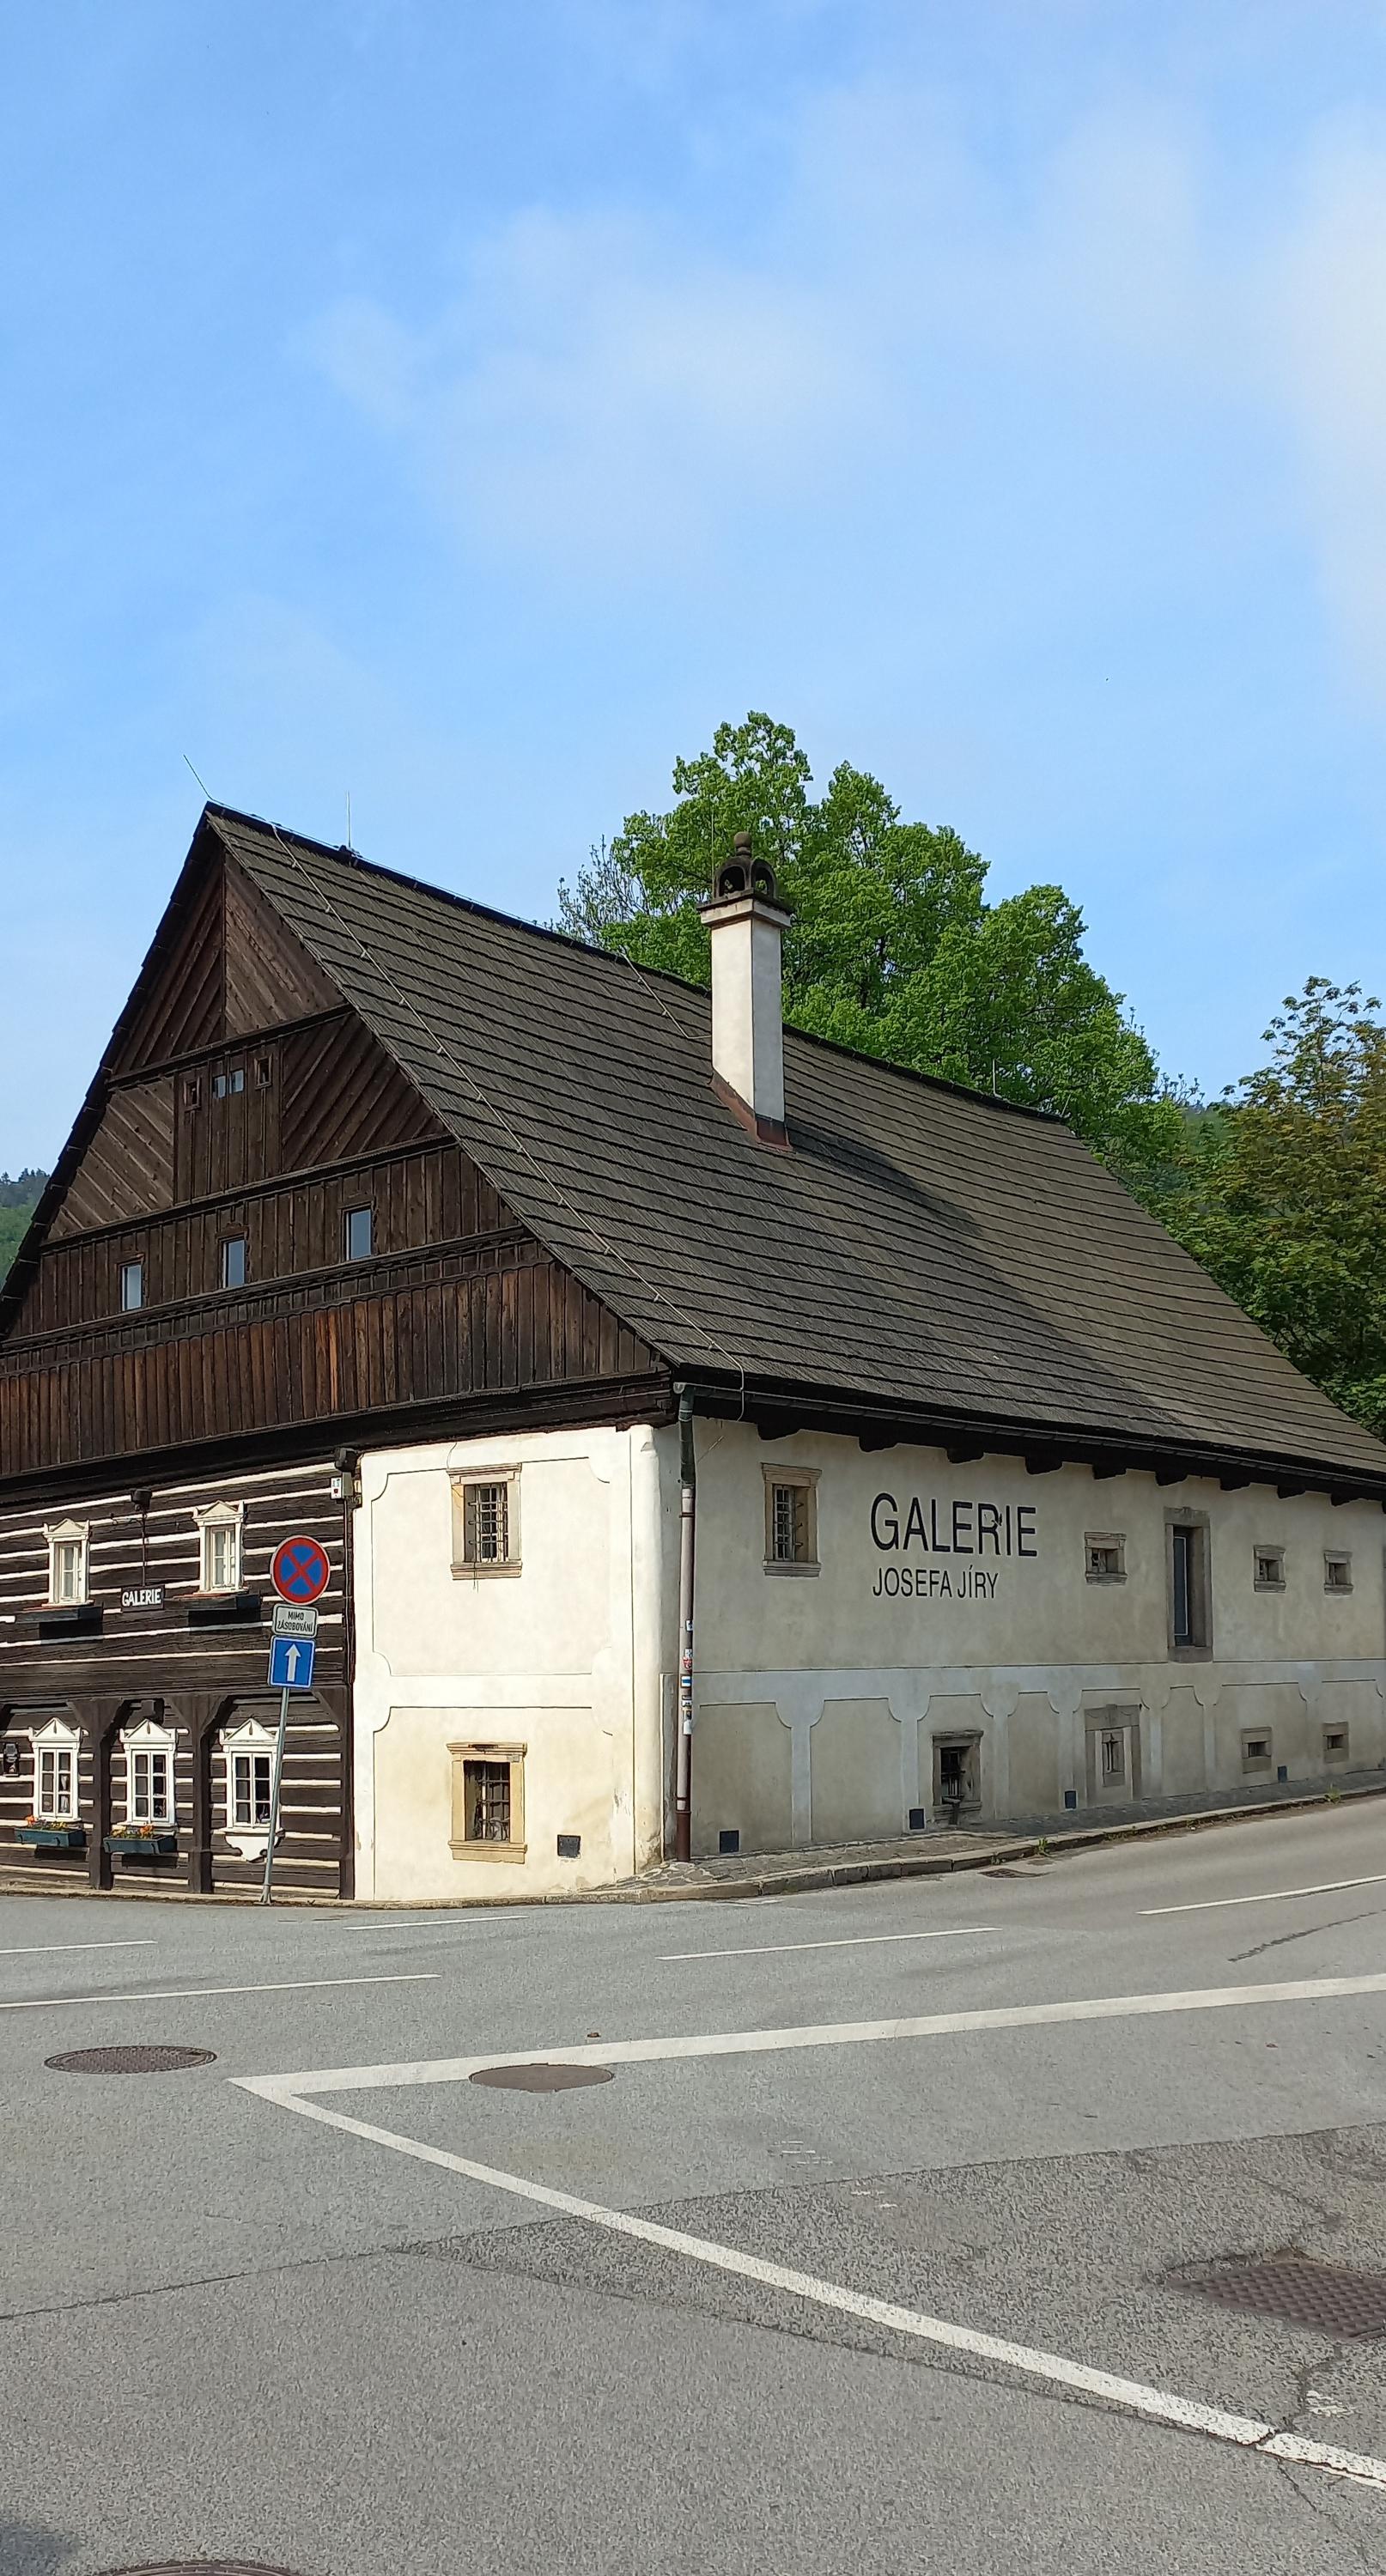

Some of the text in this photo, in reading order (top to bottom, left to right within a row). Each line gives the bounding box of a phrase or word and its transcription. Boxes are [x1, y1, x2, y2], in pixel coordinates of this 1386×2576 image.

[871, 1492, 1037, 1557] GALERIE
[872, 1564, 999, 1598] JOSEFA JÍRY
[122, 1589, 161, 1607] GALERIE
[288, 1611, 304, 1620] MIMO
[277, 1619, 313, 1632] ZÁSOBOVÁNÍ
